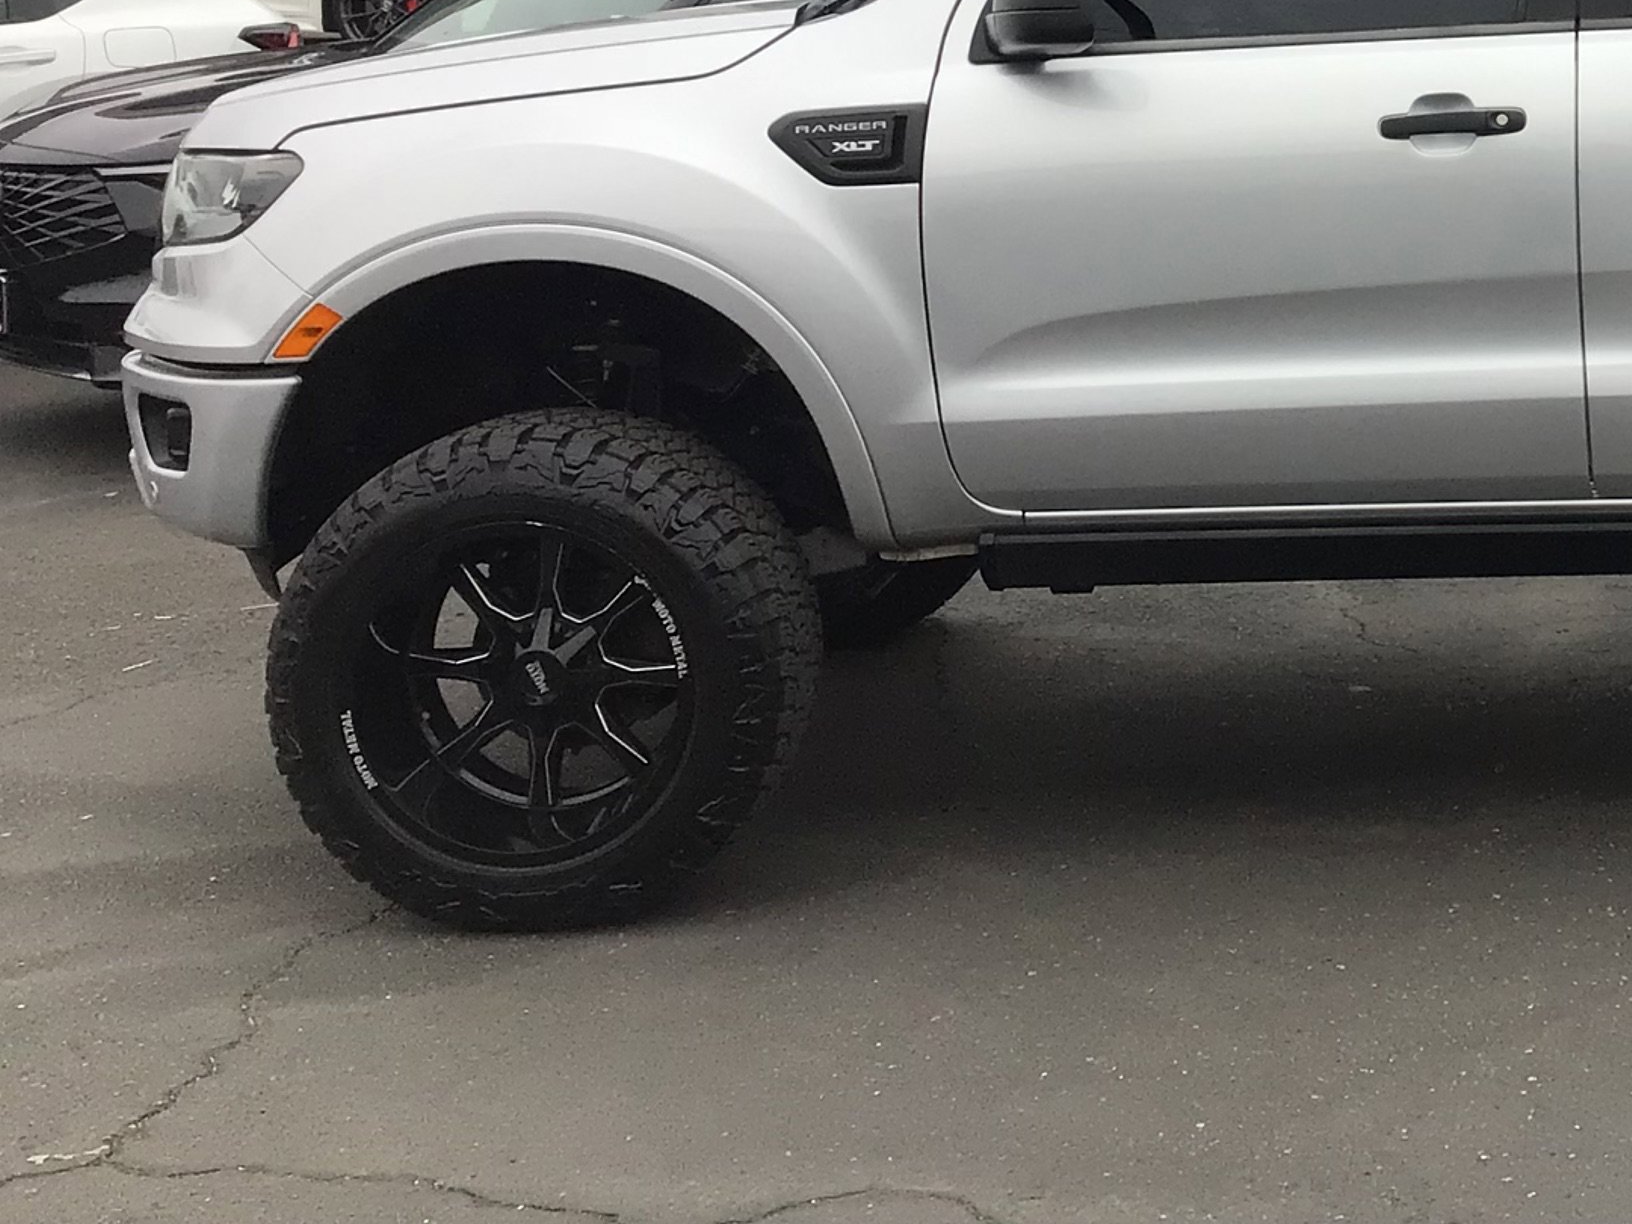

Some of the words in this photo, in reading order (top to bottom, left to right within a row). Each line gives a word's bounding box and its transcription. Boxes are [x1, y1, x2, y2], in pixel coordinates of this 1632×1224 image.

[795, 120, 887, 134] RANGER
[831, 140, 880, 153] XLT
[652, 598, 677, 634] MOTO
[669, 635, 688, 679] METAL
[340, 709, 361, 754] METAL
[353, 754, 379, 790] MOTO
